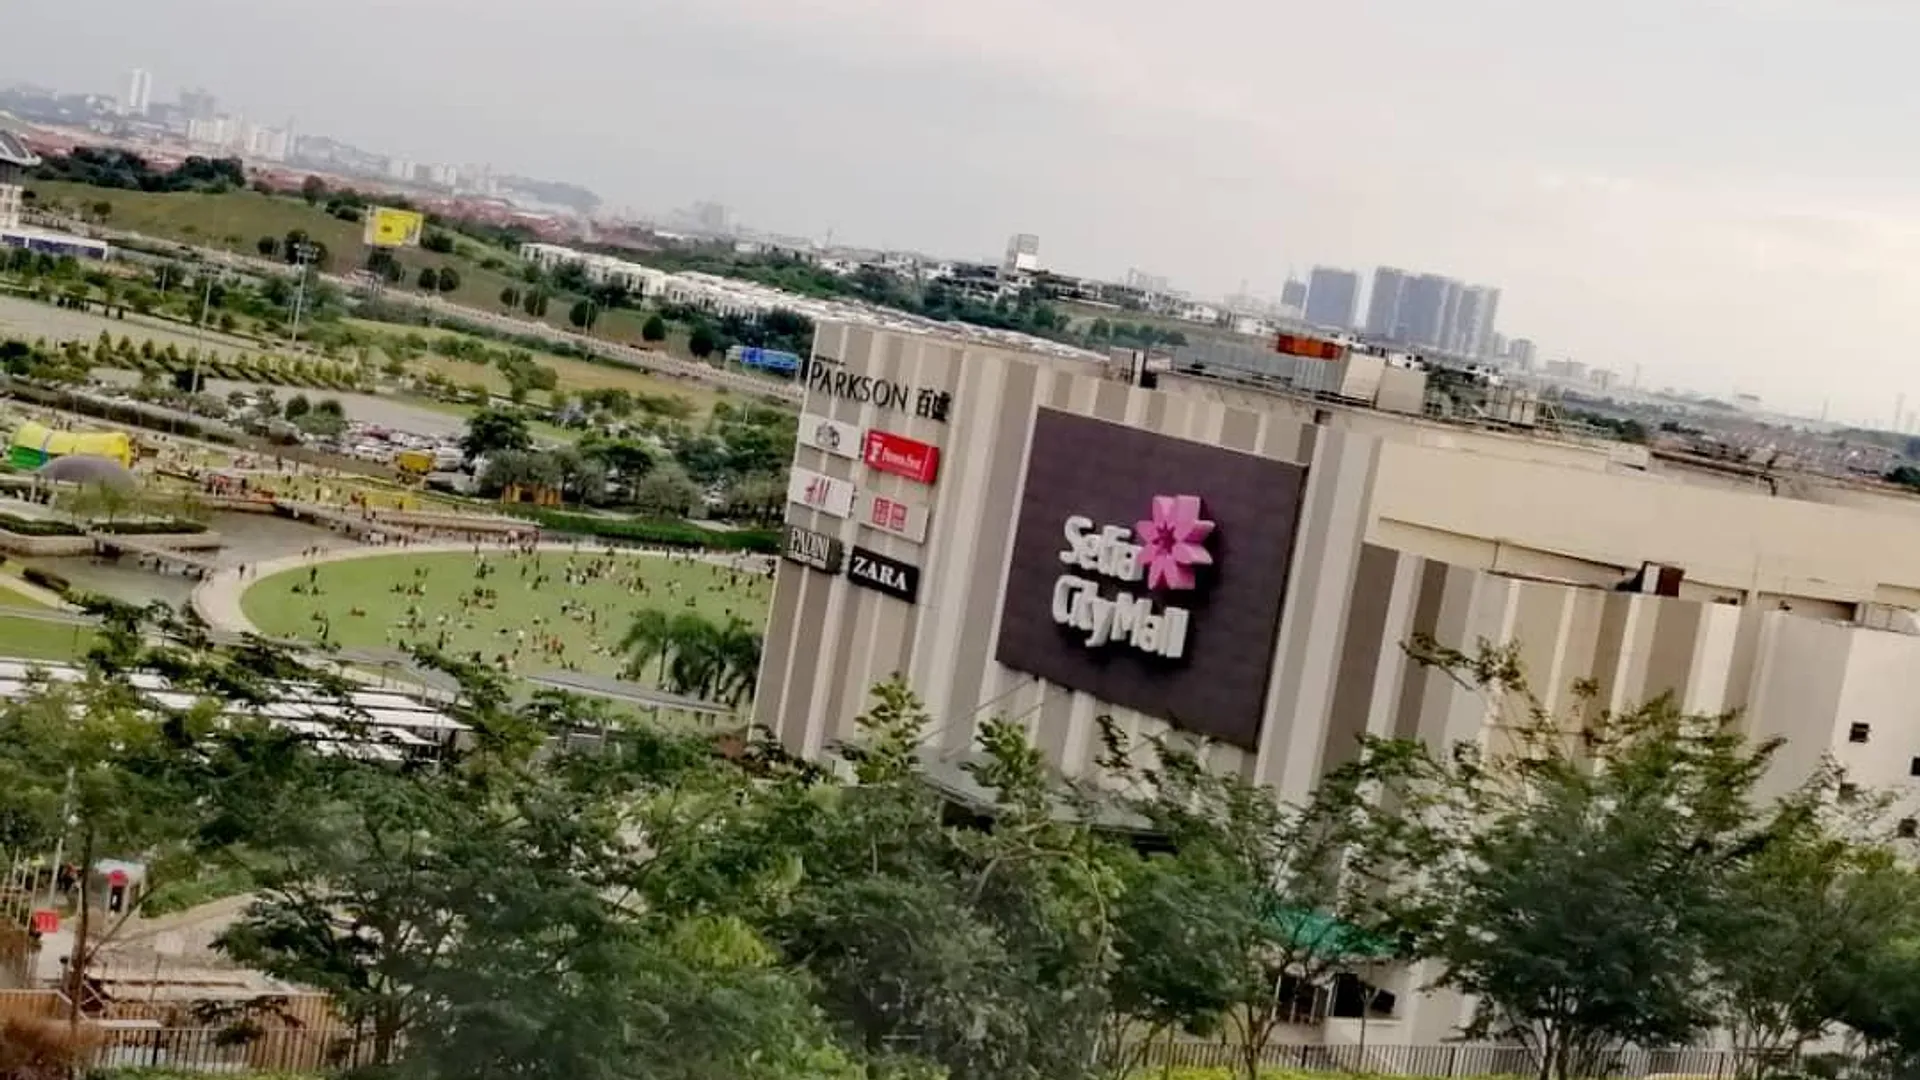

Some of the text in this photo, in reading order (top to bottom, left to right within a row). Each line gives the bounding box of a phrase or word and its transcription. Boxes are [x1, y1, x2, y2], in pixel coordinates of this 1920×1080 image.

[809, 361, 908, 412] PARKSON
[853, 555, 907, 591] ZARA
[1059, 515, 1145, 581] Setia
